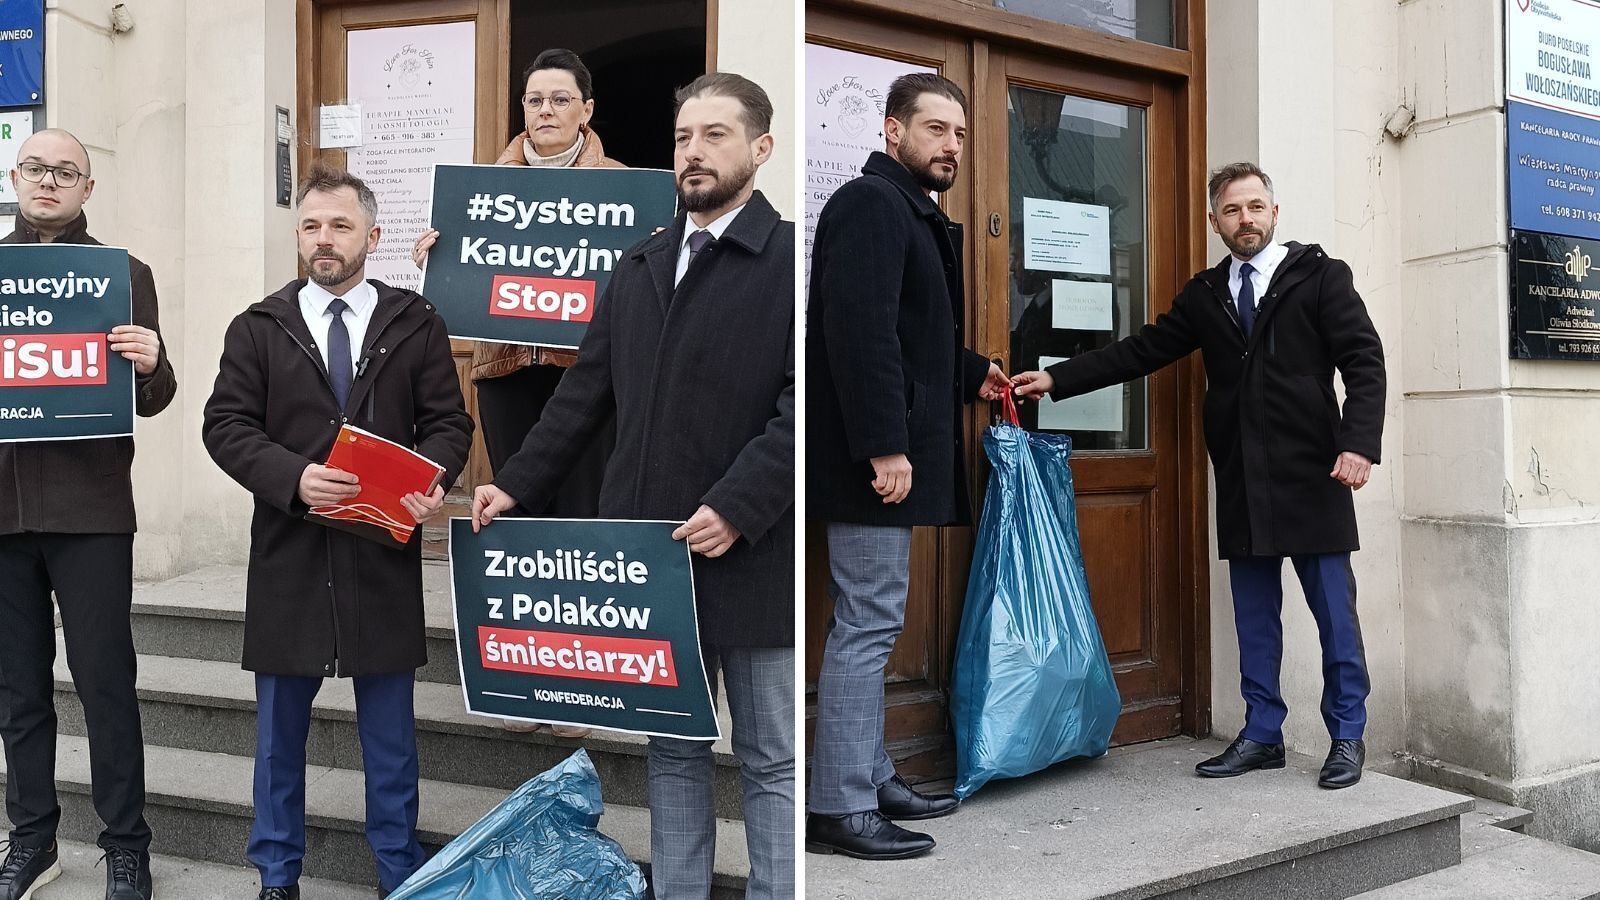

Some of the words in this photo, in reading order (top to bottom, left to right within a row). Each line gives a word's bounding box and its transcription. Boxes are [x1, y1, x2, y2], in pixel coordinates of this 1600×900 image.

[0, 29, 33, 41] WNEGO
[1538, 30, 1557, 47] BIURO
[1557, 36, 1589, 57] POSELSKIE
[1538, 49, 1591, 80] BOGUSŁAWA
[841, 75, 864, 91] For
[1525, 72, 1600, 107] WOŁOSZAŃSKIEG
[366, 110, 401, 119] TERAPIE
[406, 107, 455, 117] MANUALNE
[0, 123, 12, 139] R
[1520, 121, 1560, 138] KANCELARIA
[1561, 130, 1581, 142] RADCY
[1563, 163, 1600, 180] Martyno
[1547, 178, 1567, 189] radca
[1568, 181, 1595, 196] prawny
[466, 193, 635, 230] #System
[1541, 204, 1554, 216] tel.
[1556, 206, 1570, 217] 608
[1571, 208, 1585, 220] 371
[0, 271, 111, 299] aucyjny
[1528, 284, 1580, 299] KANCELARIA
[497, 281, 587, 321] Stop
[0, 304, 53, 327] ieło
[1566, 305, 1595, 317] Adwokat
[1549, 317, 1571, 328] Oliwia
[1592, 344, 1600, 354] 65
[0, 407, 44, 420] RACJA
[484, 548, 649, 585] Zrobiliście
[487, 597, 504, 620] z
[512, 593, 651, 630] Polaków
[485, 633, 669, 683] śmieciarzy!
[534, 688, 626, 710] KONFEDERACJA
